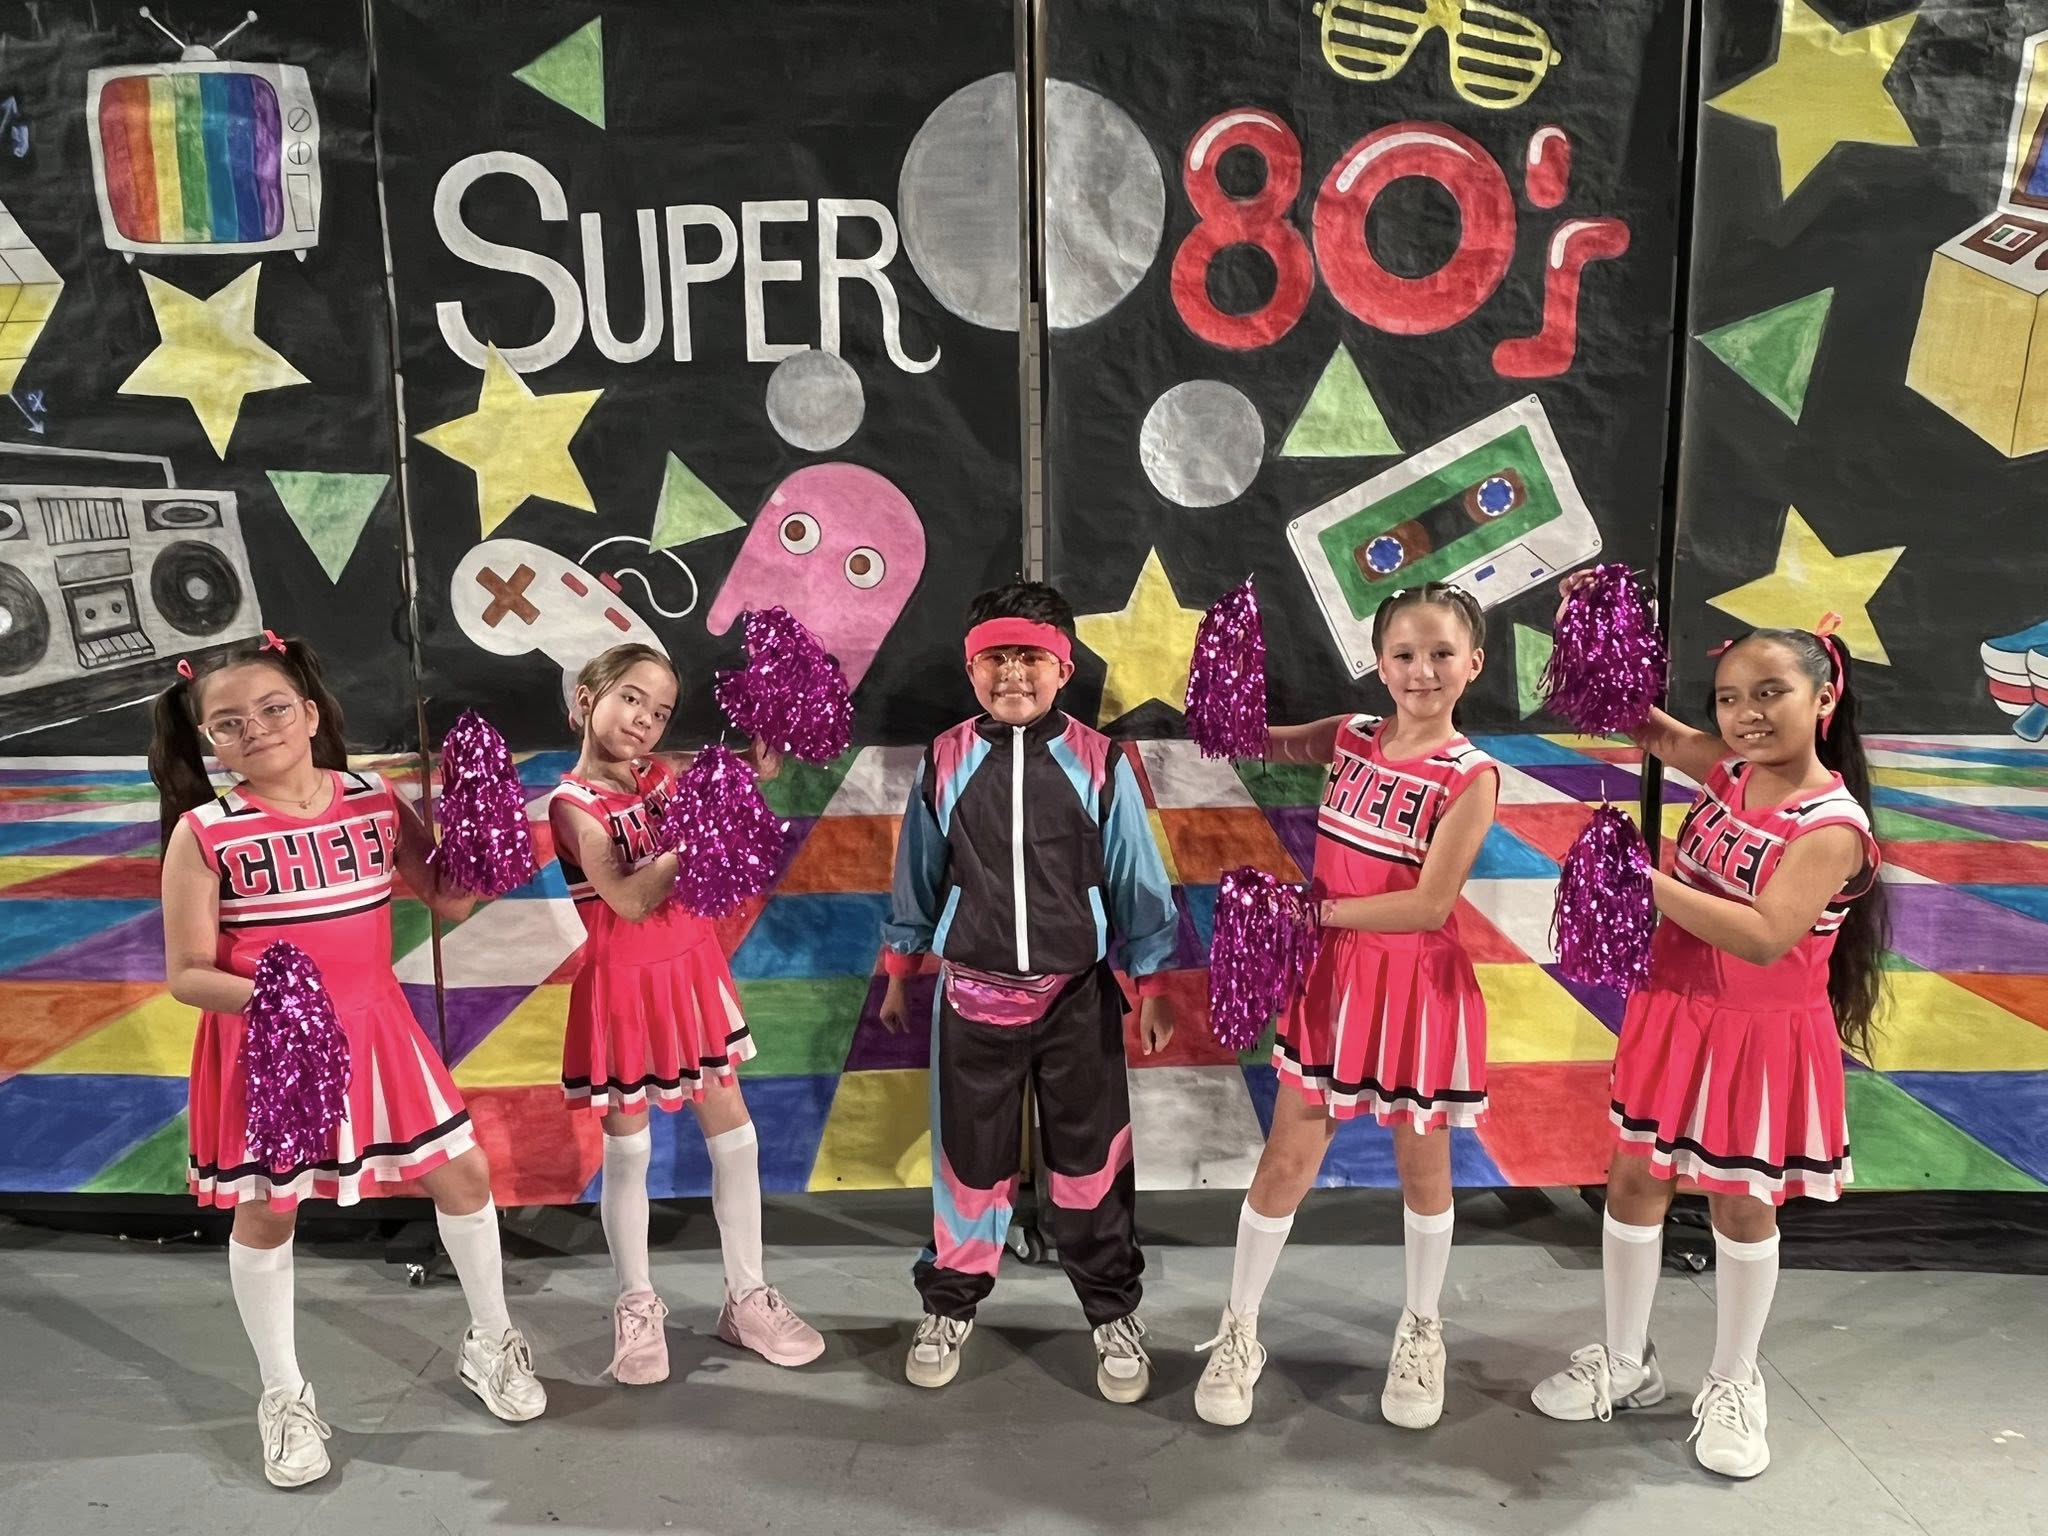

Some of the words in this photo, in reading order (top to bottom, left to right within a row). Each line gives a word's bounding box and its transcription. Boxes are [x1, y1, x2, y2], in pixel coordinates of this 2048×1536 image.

[433, 150, 941, 373] SUPER
[1170, 107, 1631, 378] 80's
[1680, 789, 1786, 896] HEE
